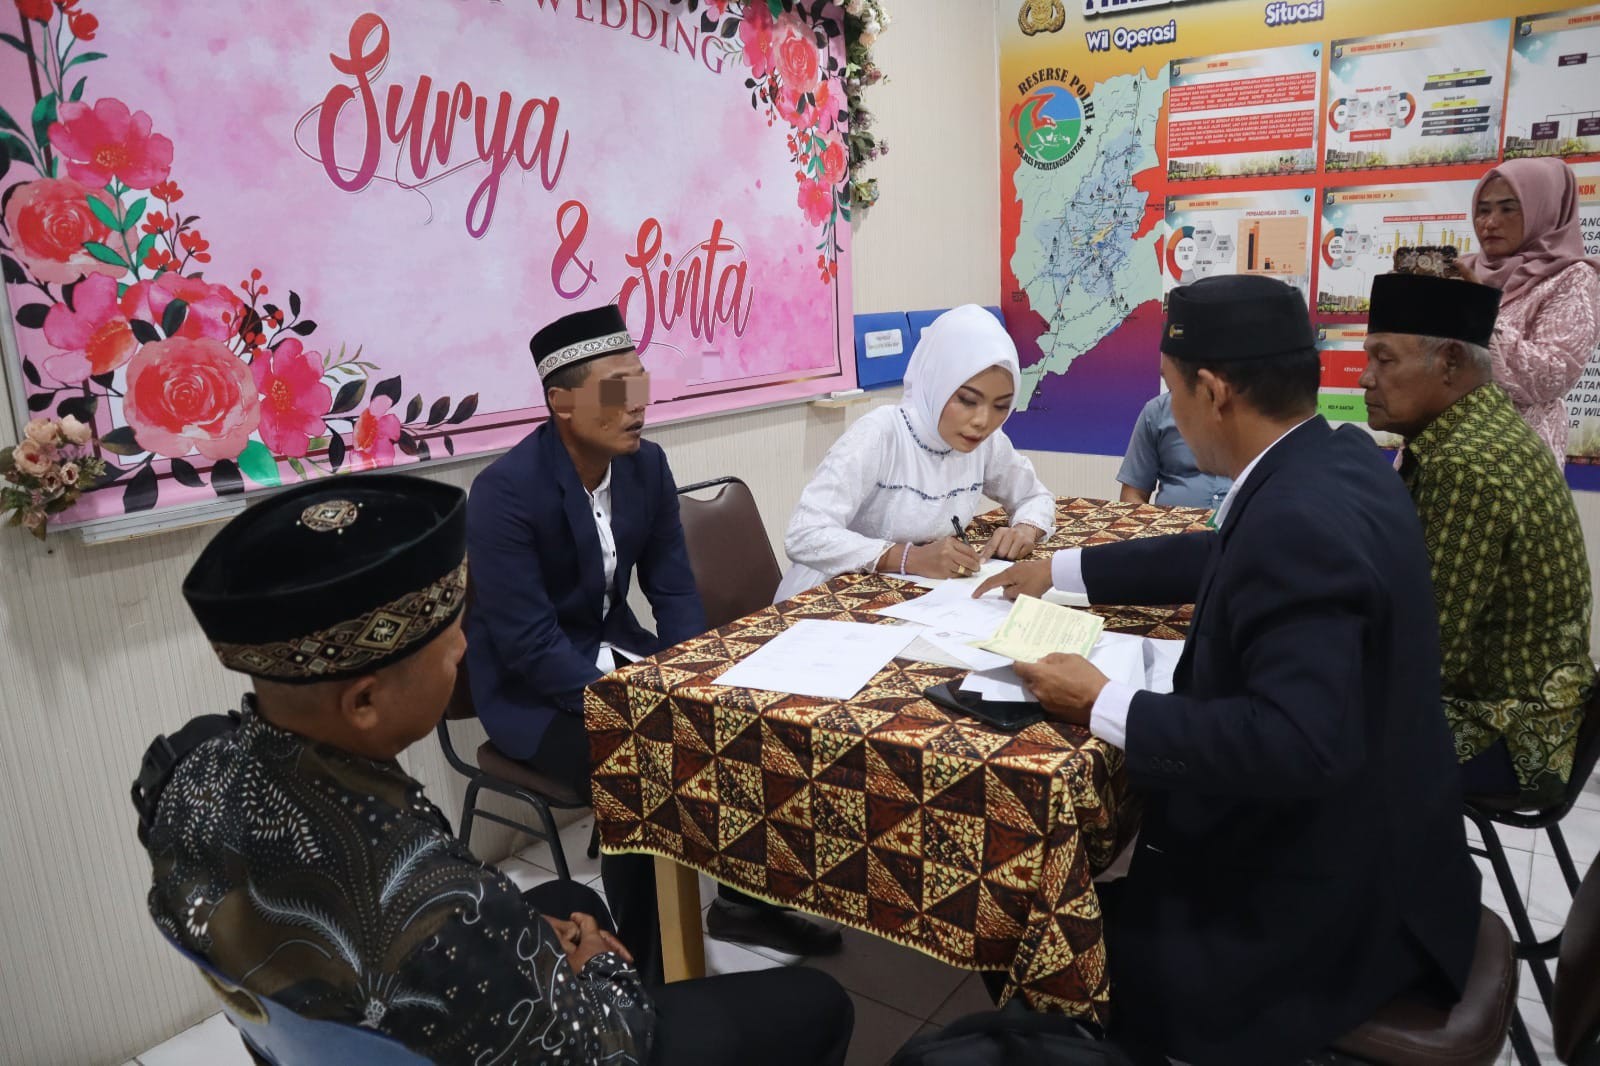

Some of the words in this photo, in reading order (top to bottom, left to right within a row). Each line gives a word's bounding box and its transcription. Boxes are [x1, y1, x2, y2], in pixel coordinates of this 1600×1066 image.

[1086, 31, 1110, 51] Wil
[1113, 20, 1176, 52] Operasi
[1265, 1, 1324, 26] Situasi
[1018, 67, 1069, 96] RESERSE
[1069, 75, 1096, 121] POLRI
[294, 12, 570, 240] Surya
[1013, 142, 1034, 166] POLRES
[551, 200, 597, 300] &
[608, 217, 755, 357] Sinta
